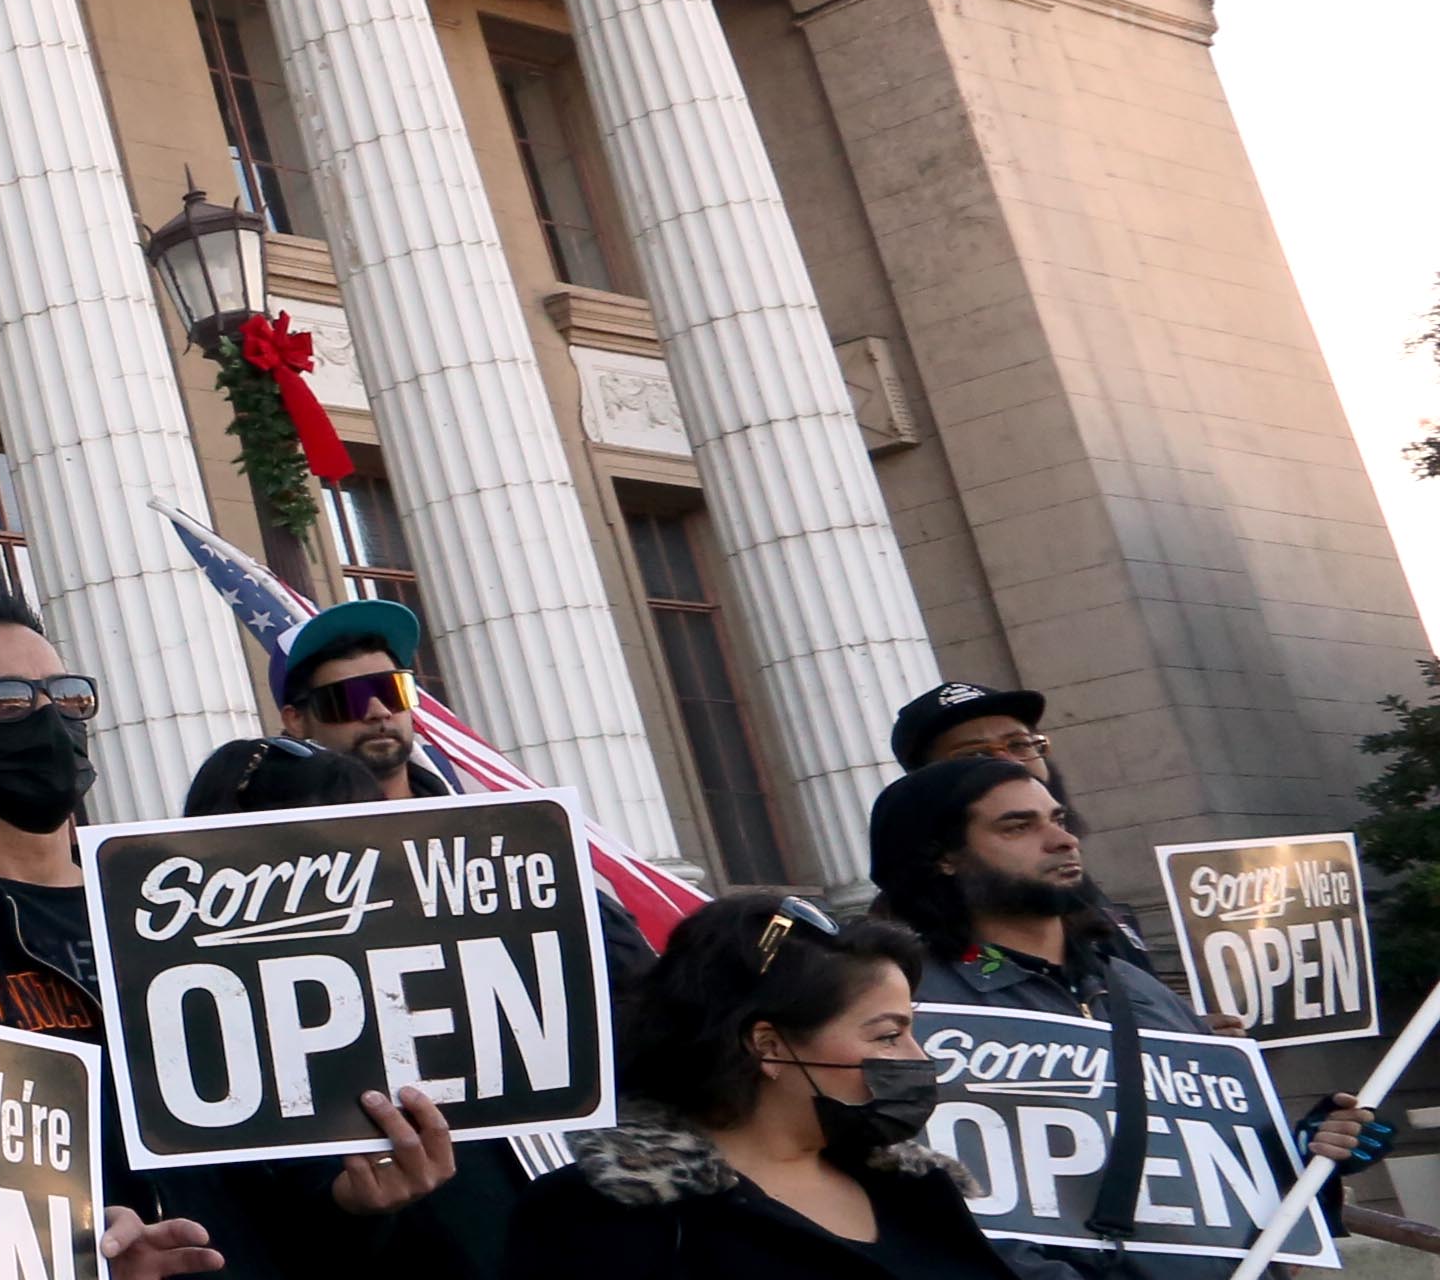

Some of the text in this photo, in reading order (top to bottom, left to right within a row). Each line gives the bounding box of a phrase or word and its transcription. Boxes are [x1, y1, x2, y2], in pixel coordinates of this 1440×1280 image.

[134, 835, 558, 947] Sorry We're
[1188, 860, 1352, 921] Sorry We're
[1202, 917, 1361, 1028] OPEN
[146, 930, 571, 1128] OPEN
[922, 1028, 1118, 1100] Sorry
